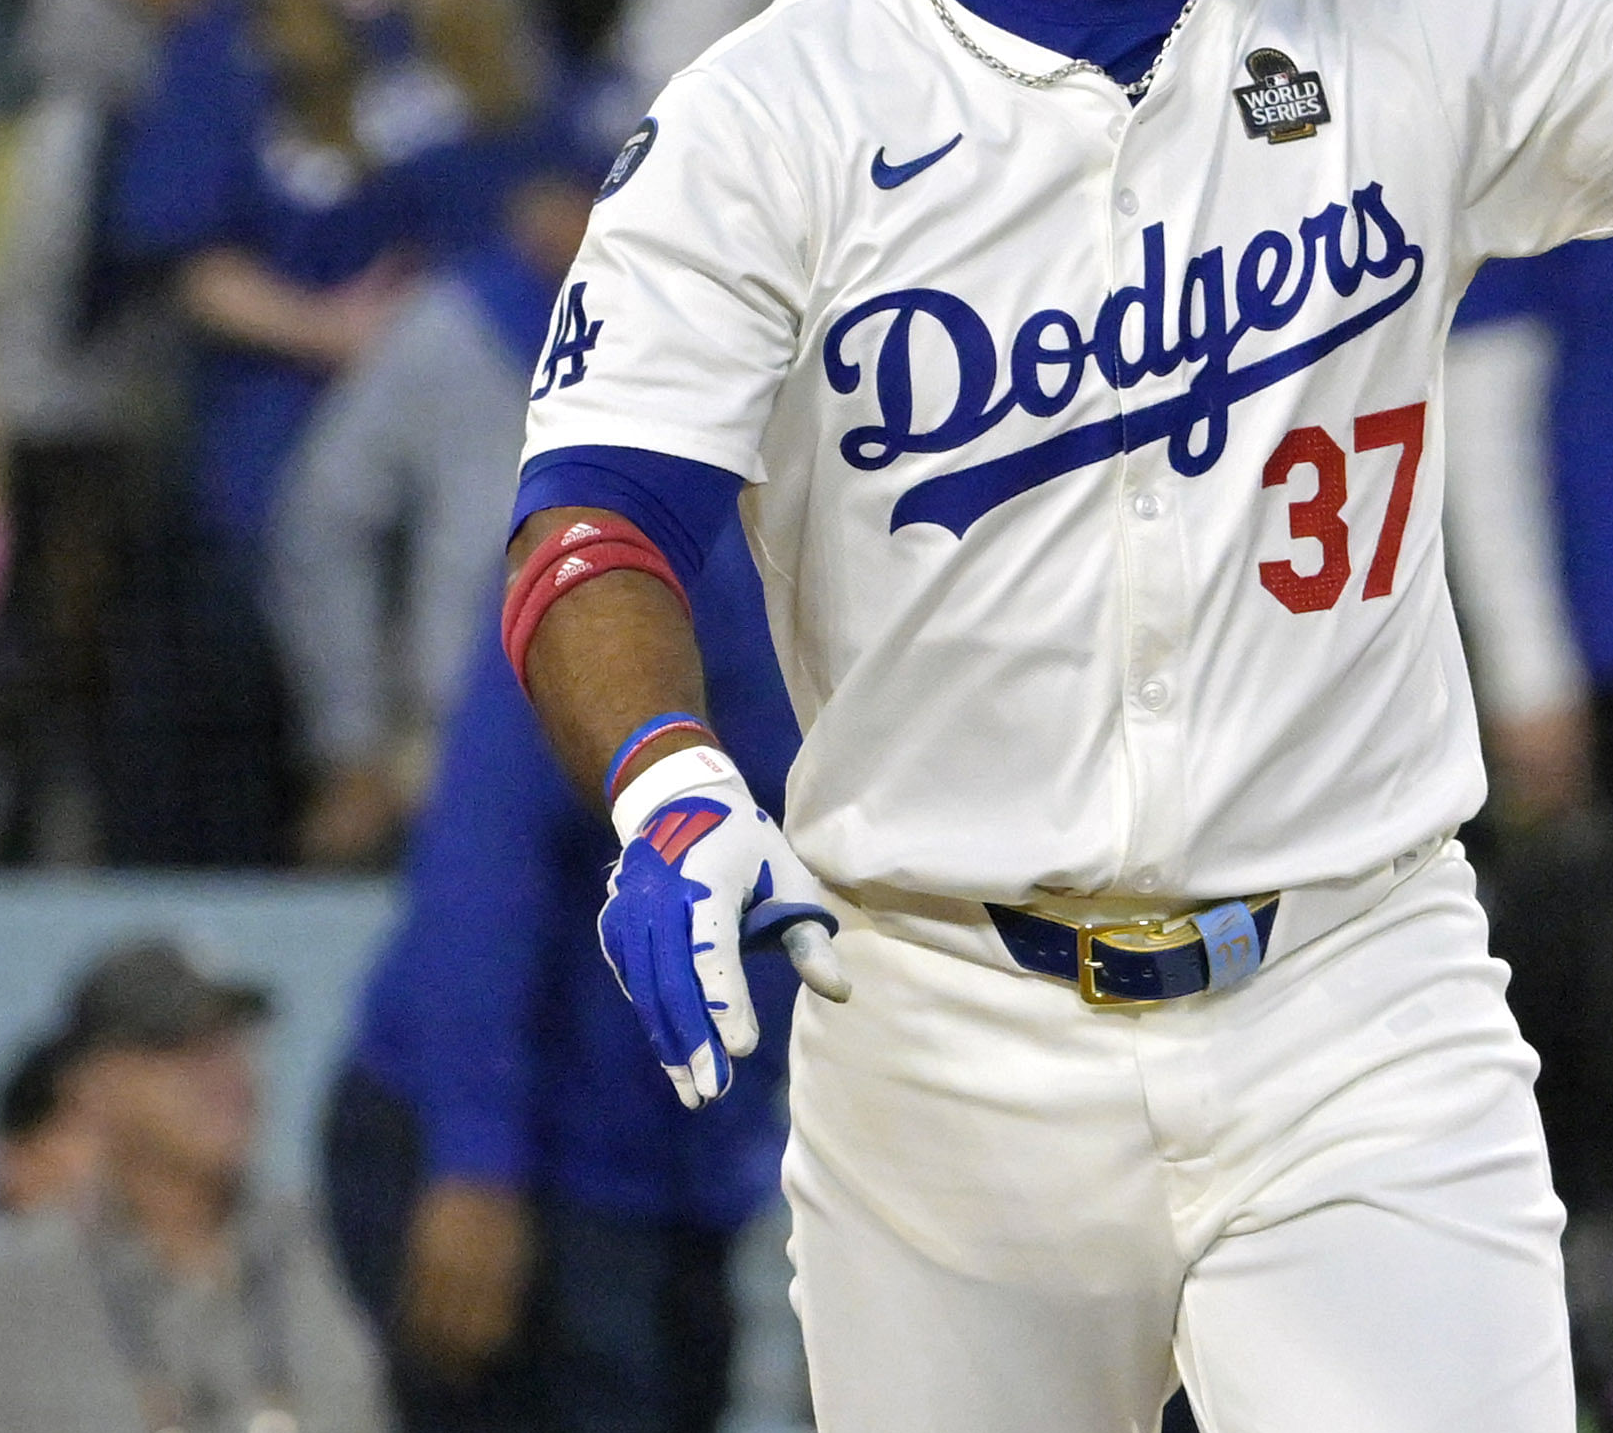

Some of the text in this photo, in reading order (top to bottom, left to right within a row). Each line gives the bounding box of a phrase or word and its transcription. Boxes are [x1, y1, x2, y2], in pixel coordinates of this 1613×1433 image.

[1242, 81, 1319, 111] WORLD
[1251, 97, 1322, 126] SERIES
[823, 181, 1425, 478] Dodgers
[1259, 401, 1427, 614] 37
[560, 527, 602, 547] adidas
[554, 562, 594, 587] adidas
